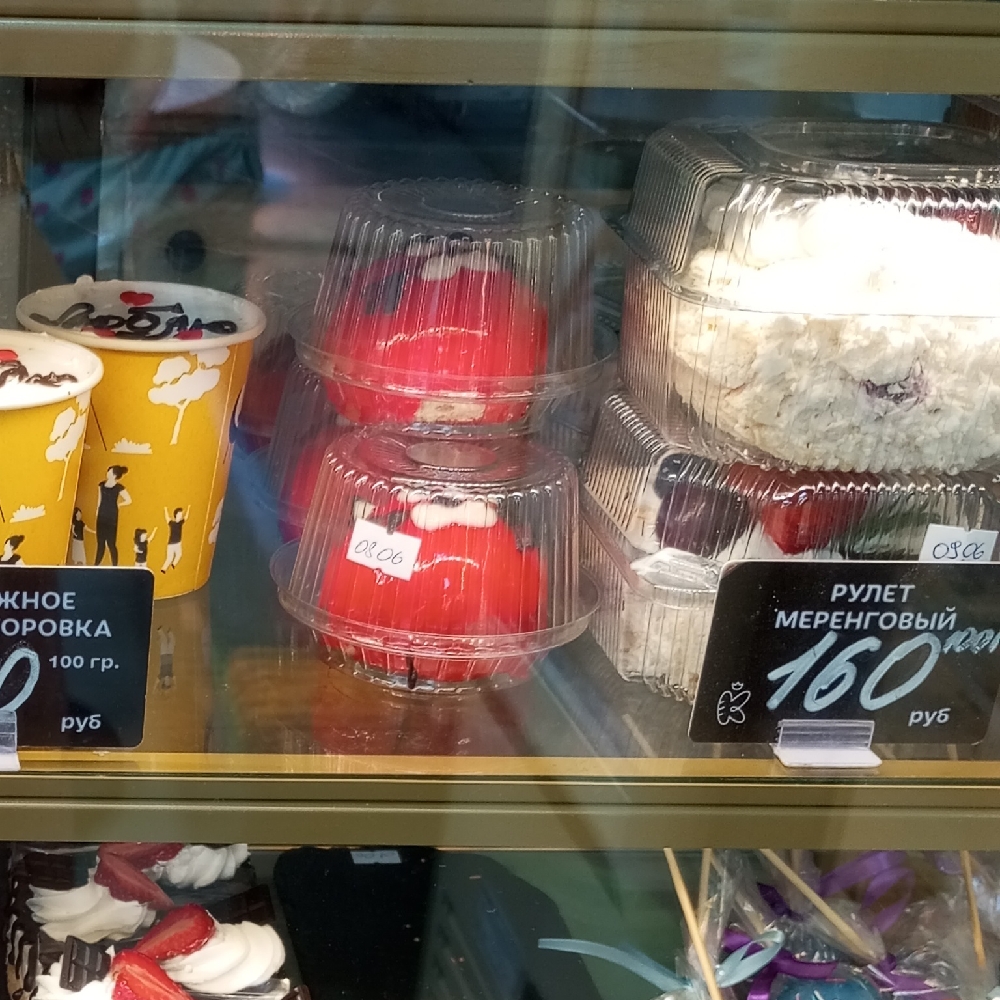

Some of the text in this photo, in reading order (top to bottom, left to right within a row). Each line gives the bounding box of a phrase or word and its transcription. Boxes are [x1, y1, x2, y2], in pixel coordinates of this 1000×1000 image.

[830, 584, 916, 603] РУЛЕТ
[774, 606, 957, 631] МЕРЕНГОВЫЙ
[48, 655, 120, 672] 100 гр.
[766, 631, 942, 712] 160
[61, 714, 102, 733] руб
[907, 708, 951, 727] руб
